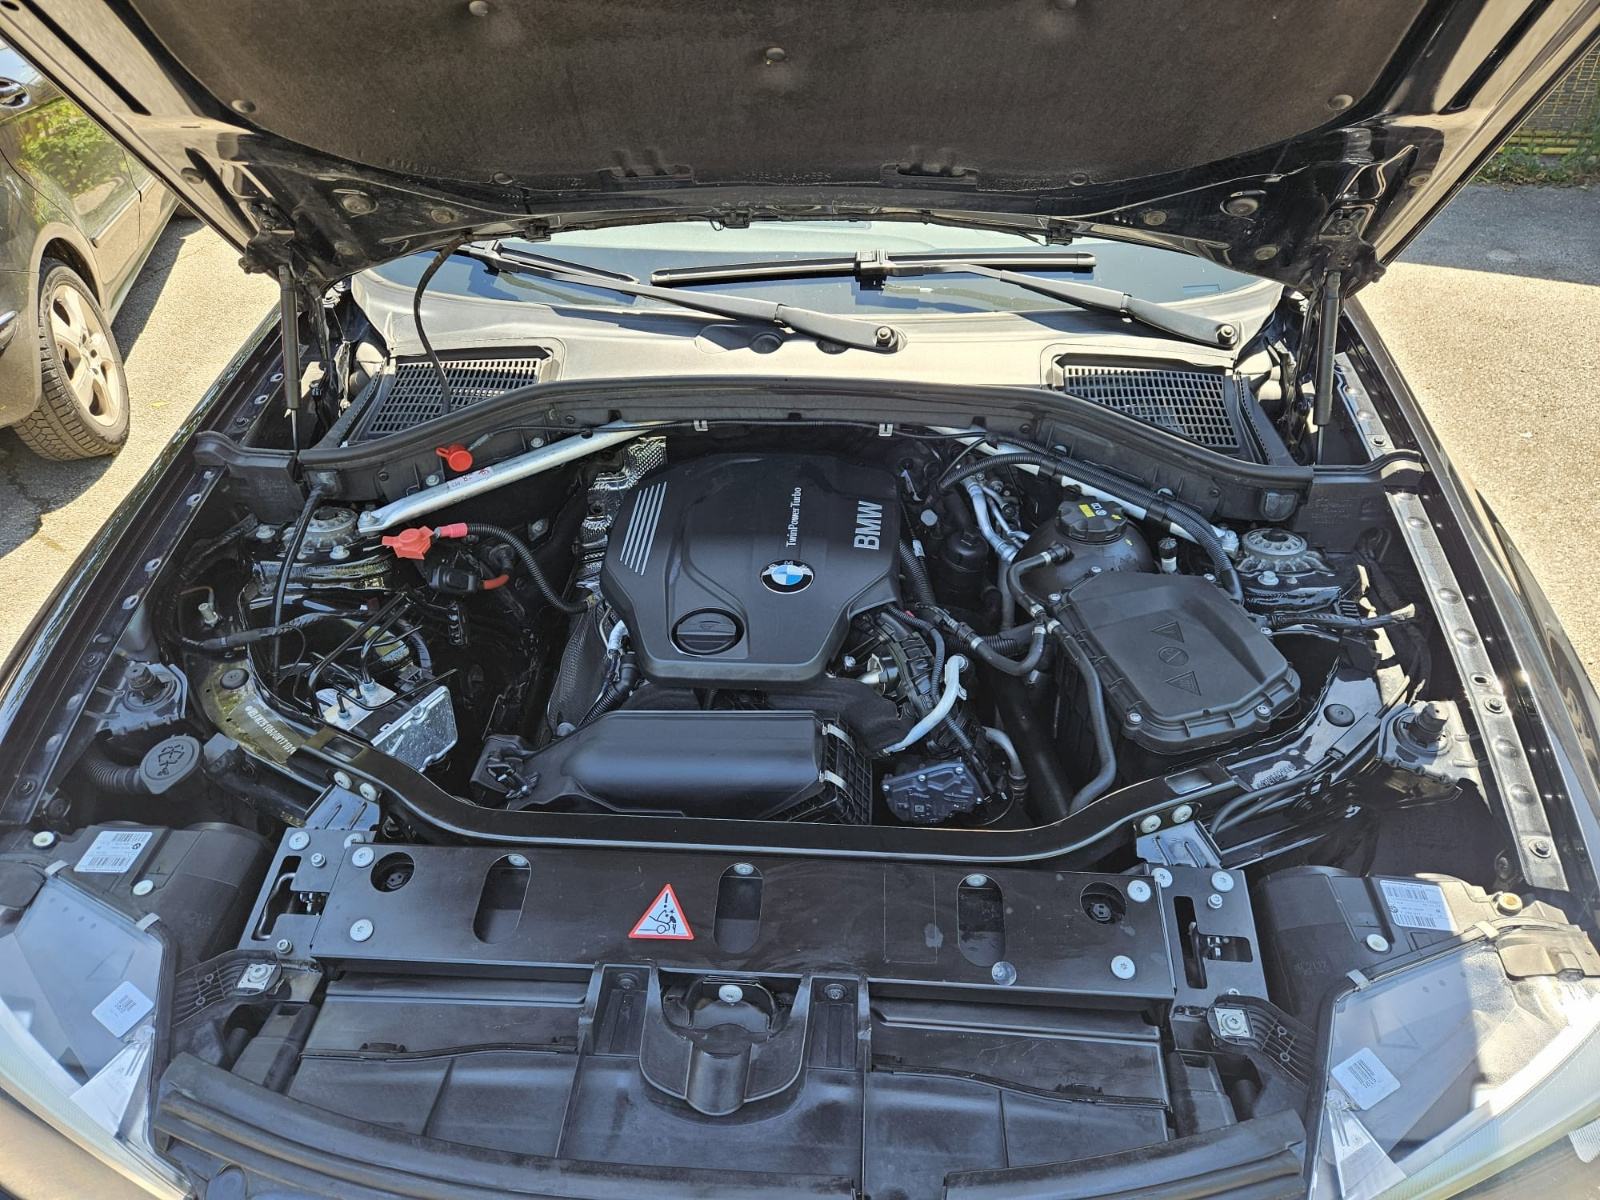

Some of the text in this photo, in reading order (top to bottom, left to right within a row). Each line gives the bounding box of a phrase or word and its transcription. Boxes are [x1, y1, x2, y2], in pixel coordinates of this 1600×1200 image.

[785, 487, 802, 548] TwinPower Turbo
[853, 500, 883, 551] BMW
